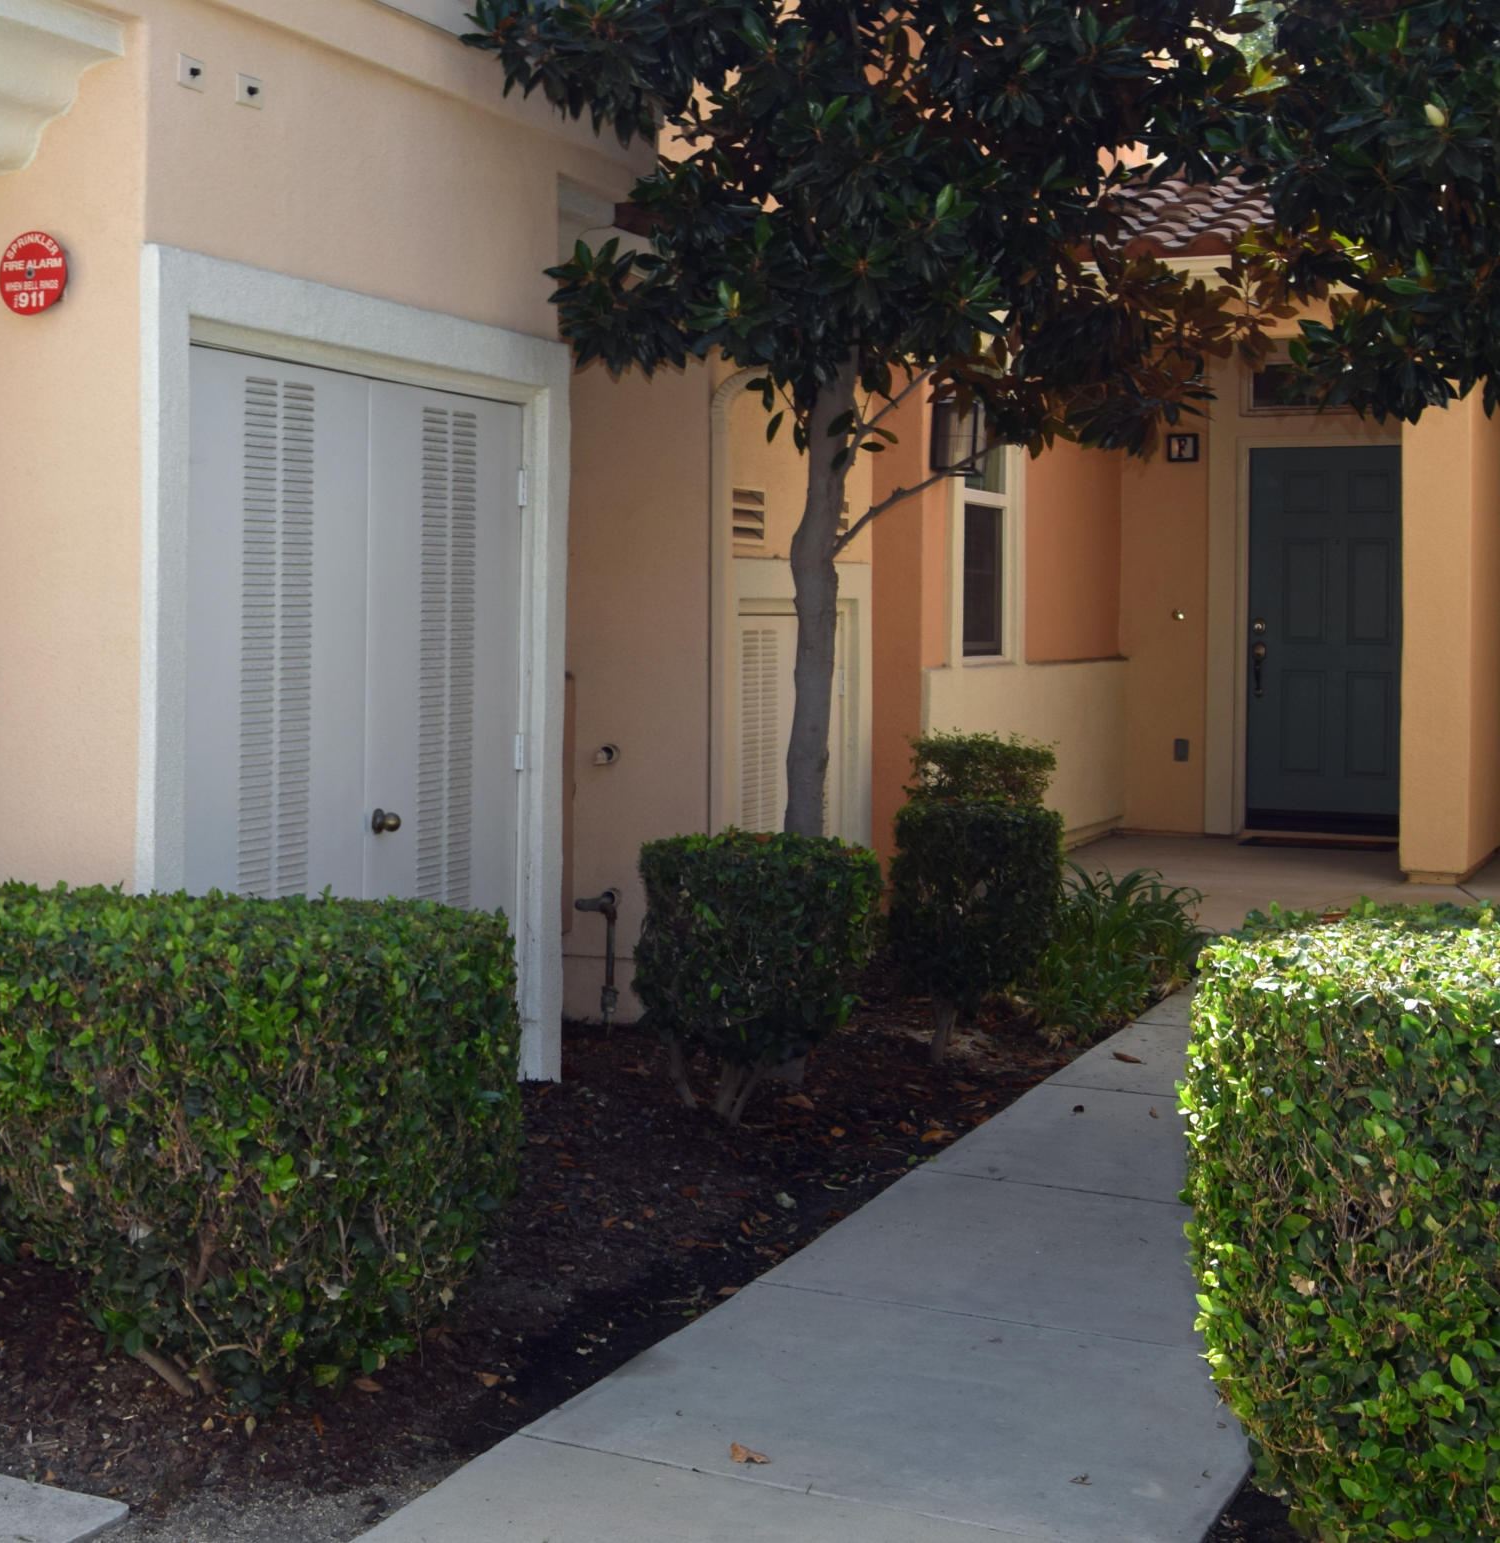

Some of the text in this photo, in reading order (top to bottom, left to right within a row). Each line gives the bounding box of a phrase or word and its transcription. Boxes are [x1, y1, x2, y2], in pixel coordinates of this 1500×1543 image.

[6, 233, 60, 259] SPRINKLER
[3, 257, 62, 271] FIRE ALARM
[23, 280, 38, 291] BELL
[39, 279, 59, 290] RINGS
[19, 291, 45, 308] 911
